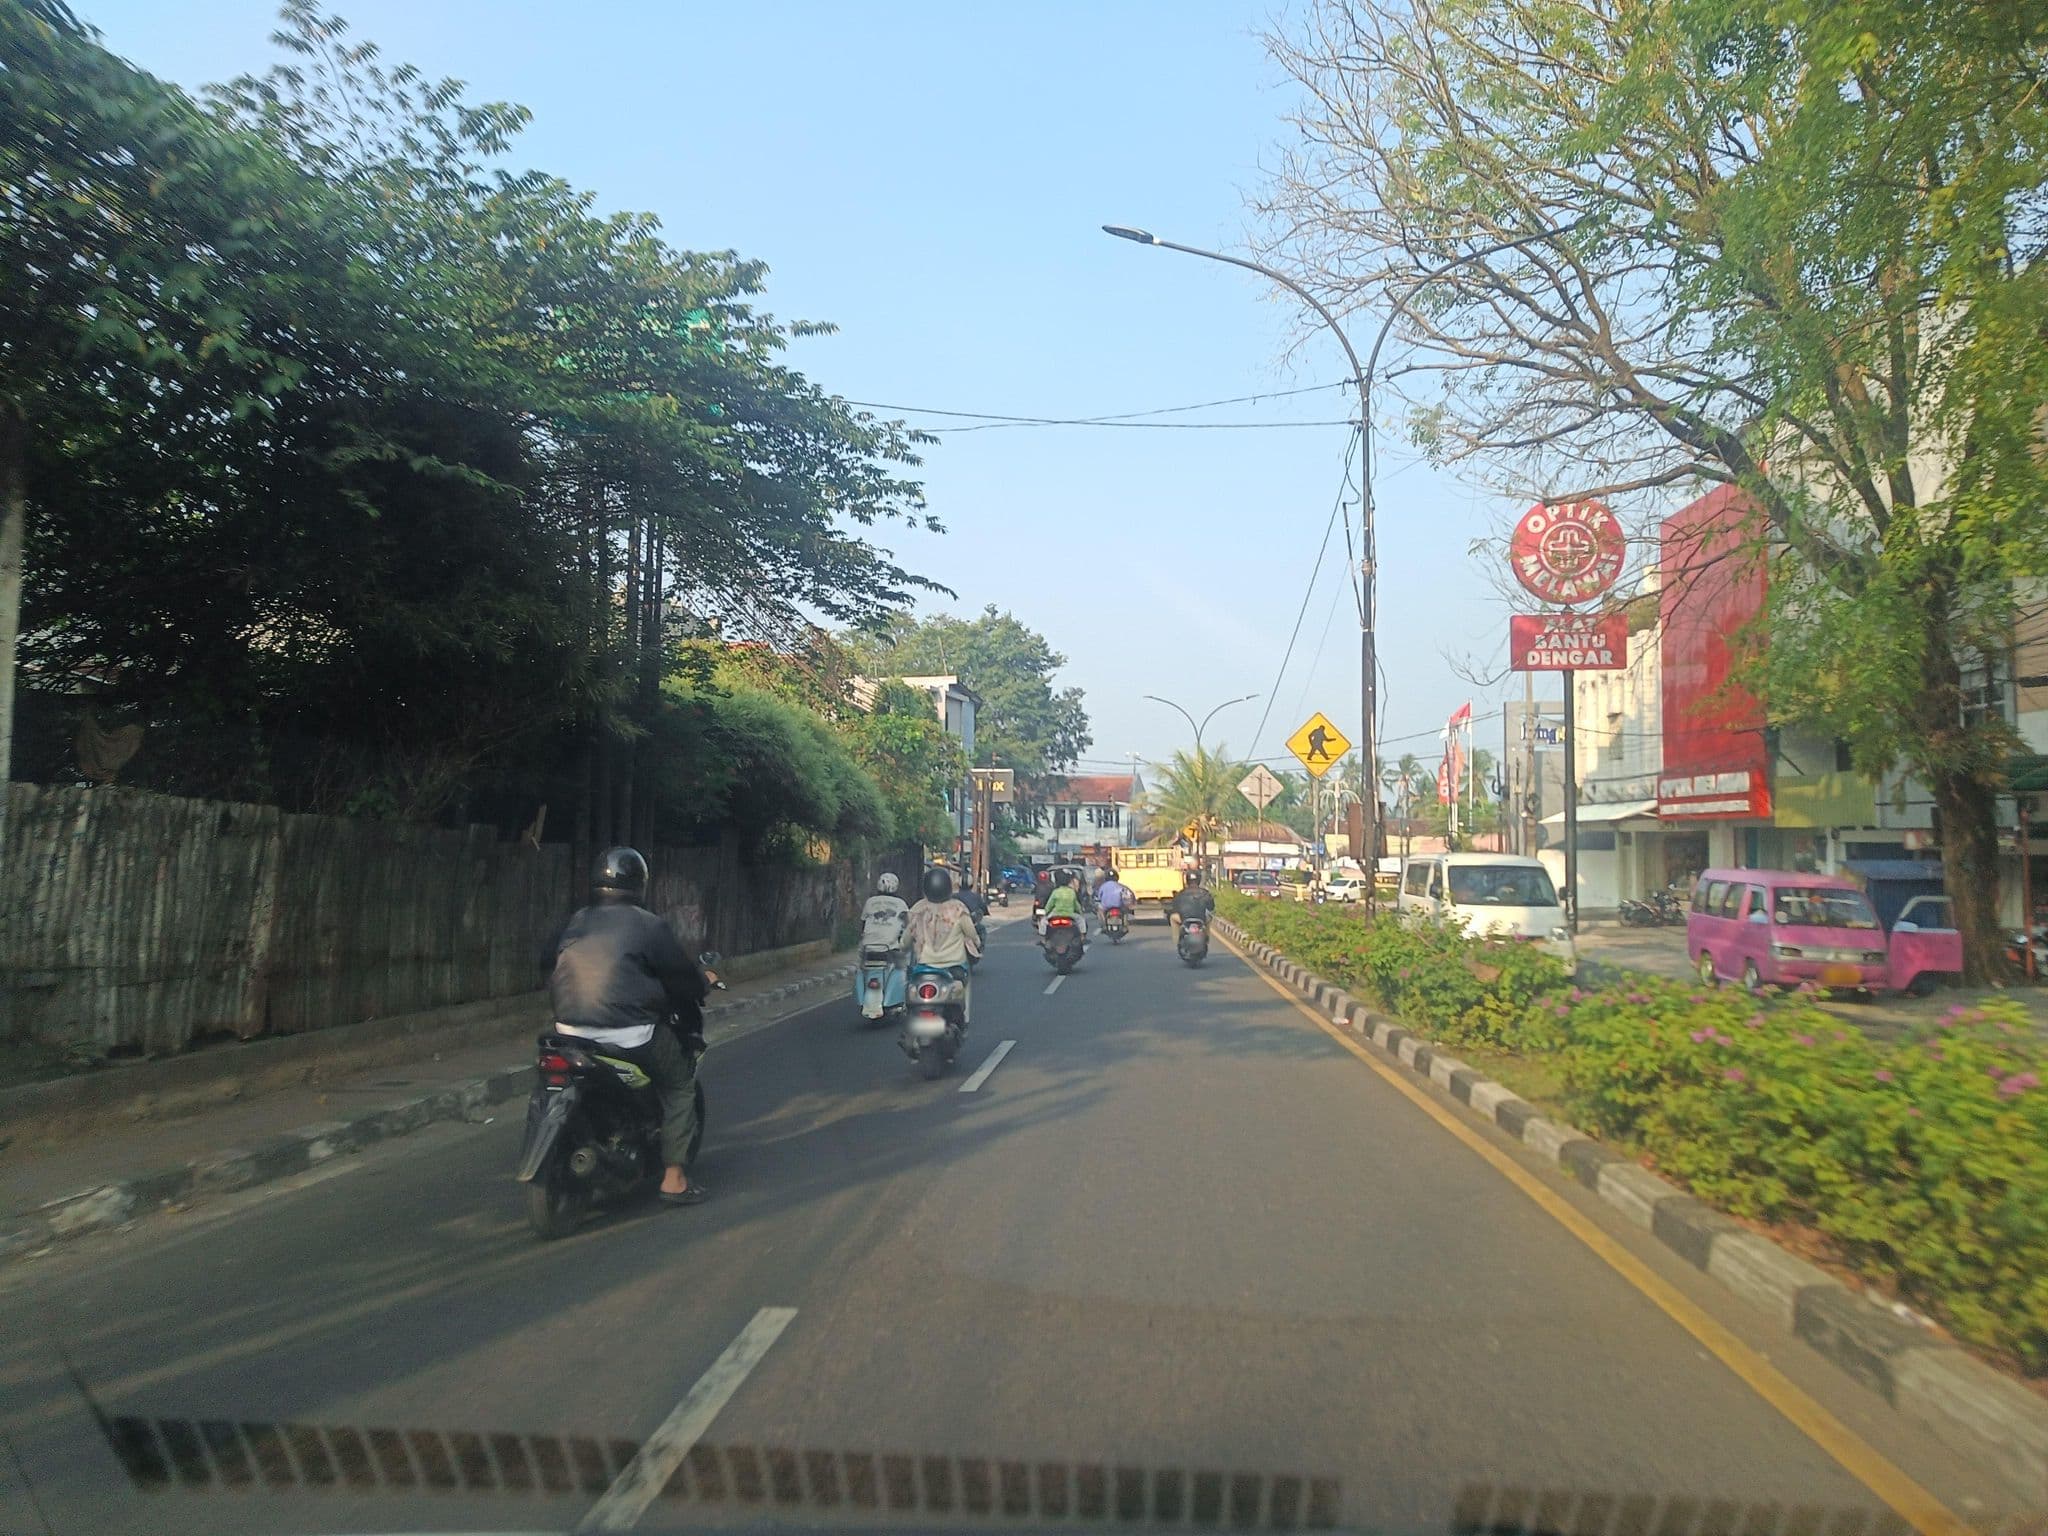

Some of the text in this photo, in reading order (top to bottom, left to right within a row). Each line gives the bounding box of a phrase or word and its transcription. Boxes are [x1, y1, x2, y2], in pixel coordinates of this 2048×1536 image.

[1527, 503, 1609, 533] OPTIK
[1535, 634, 1606, 649] BANTU
[1527, 651, 1614, 666] DENGAR
